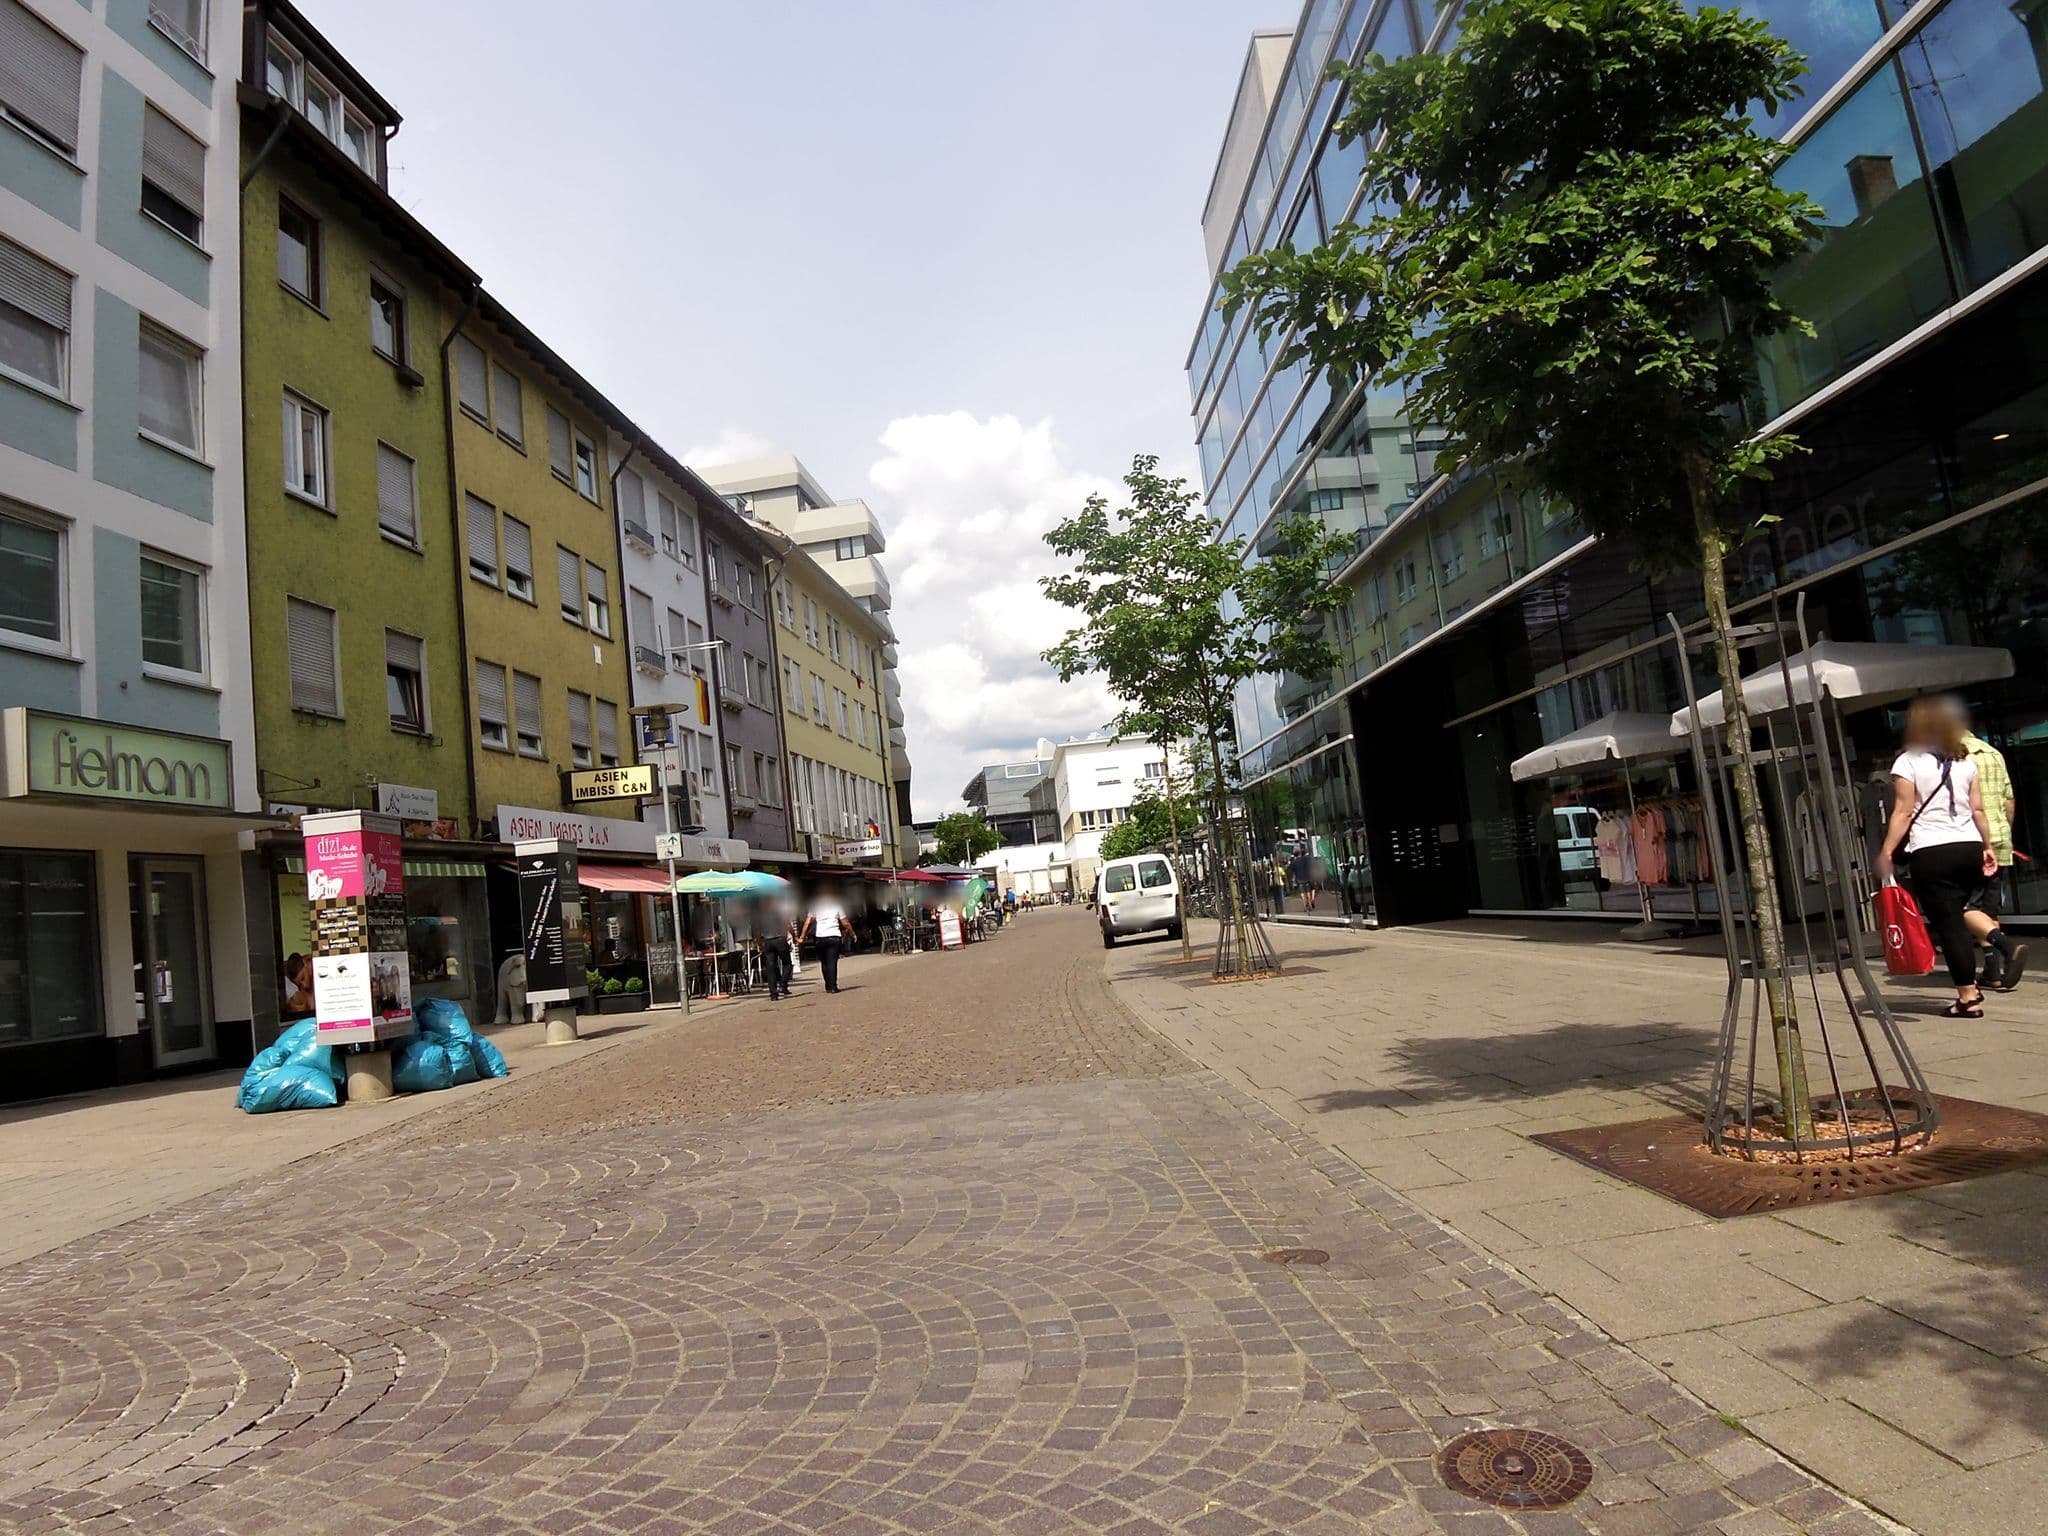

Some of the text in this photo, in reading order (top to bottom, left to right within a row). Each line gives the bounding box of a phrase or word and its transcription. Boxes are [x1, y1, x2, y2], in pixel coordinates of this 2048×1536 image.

[53, 727, 211, 800] fielmann
[594, 770, 629, 783] ASIEN
[575, 782, 647, 798] IMBISS C&N
[510, 817, 542, 840] ASIEN
